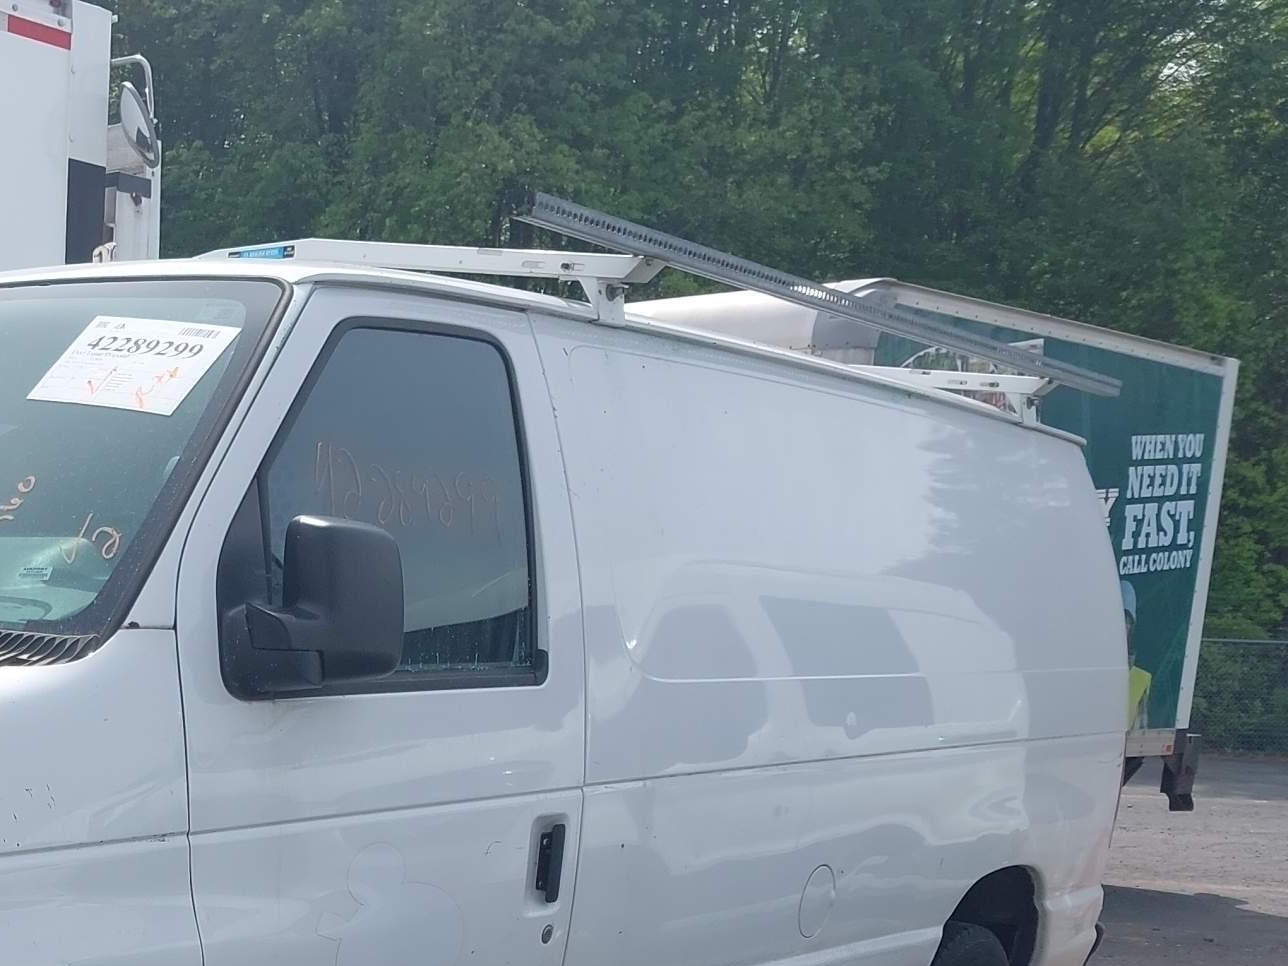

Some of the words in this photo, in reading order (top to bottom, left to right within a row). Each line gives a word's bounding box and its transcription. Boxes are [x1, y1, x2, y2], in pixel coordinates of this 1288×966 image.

[87, 335, 204, 359] 42289299
[1131, 434, 1176, 460] WHEN
[1177, 433, 1205, 459] YOU
[1126, 464, 1179, 499] NEED
[1180, 463, 1202, 495] IT
[1121, 500, 1195, 550] FAST,
[1119, 553, 1148, 576] CALL
[1149, 549, 1193, 573] COLONY
